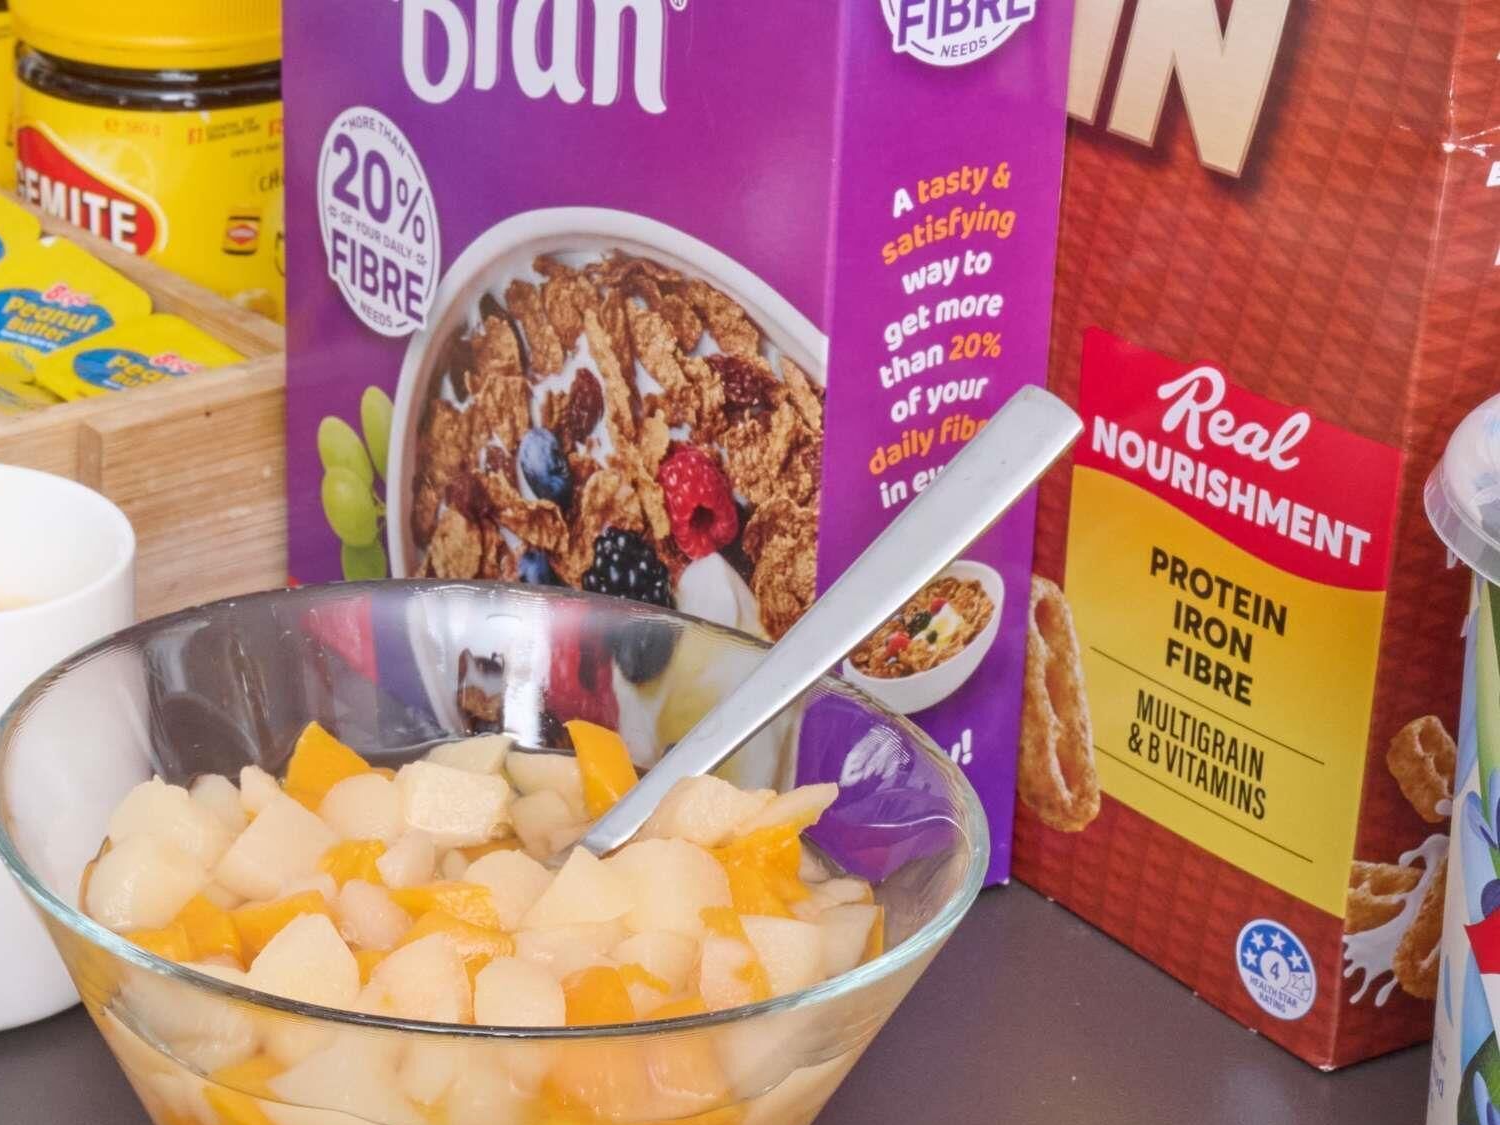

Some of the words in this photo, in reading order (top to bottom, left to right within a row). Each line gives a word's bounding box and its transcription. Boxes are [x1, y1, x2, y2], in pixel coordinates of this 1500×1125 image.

[940, 36, 988, 58] NEEDS
[348, 116, 377, 131] MORE
[378, 122, 406, 158] THAN
[332, 133, 426, 245] 20%
[893, 187, 915, 218] A
[917, 165, 989, 205] tasty
[991, 161, 1011, 189] &
[341, 211, 353, 227] OF
[356, 219, 382, 243] YOUR
[383, 232, 413, 259] DAILY
[881, 201, 1017, 265] satisfying
[332, 228, 424, 323] FIBRE
[902, 256, 960, 295] way
[963, 249, 992, 276] to
[3, 295, 100, 332] Peanut
[359, 301, 393, 328] NEEDS
[884, 305, 931, 351] get
[935, 293, 1004, 324] more
[879, 344, 944, 389] than
[949, 332, 1002, 361] 20%
[890, 386, 923, 423] of
[926, 377, 990, 415] your
[1157, 366, 1311, 472] Real
[868, 427, 935, 475] daily
[879, 480, 908, 509] in
[1092, 415, 1372, 566] NOURISHMENT
[1150, 545, 1288, 637] PROTEIN
[1173, 600, 1253, 664] IRON
[1165, 638, 1253, 706] FIBRE
[1136, 688, 1265, 783] MULTIGRAIN
[1128, 722, 1142, 757] &
[1147, 731, 1160, 765] B
[1166, 740, 1267, 820] VITAMINS
[1250, 975, 1278, 998] HEALTH
[1279, 989, 1298, 1009] STAR
[1270, 962, 1280, 980] 4
[1259, 991, 1286, 1014] RATING
